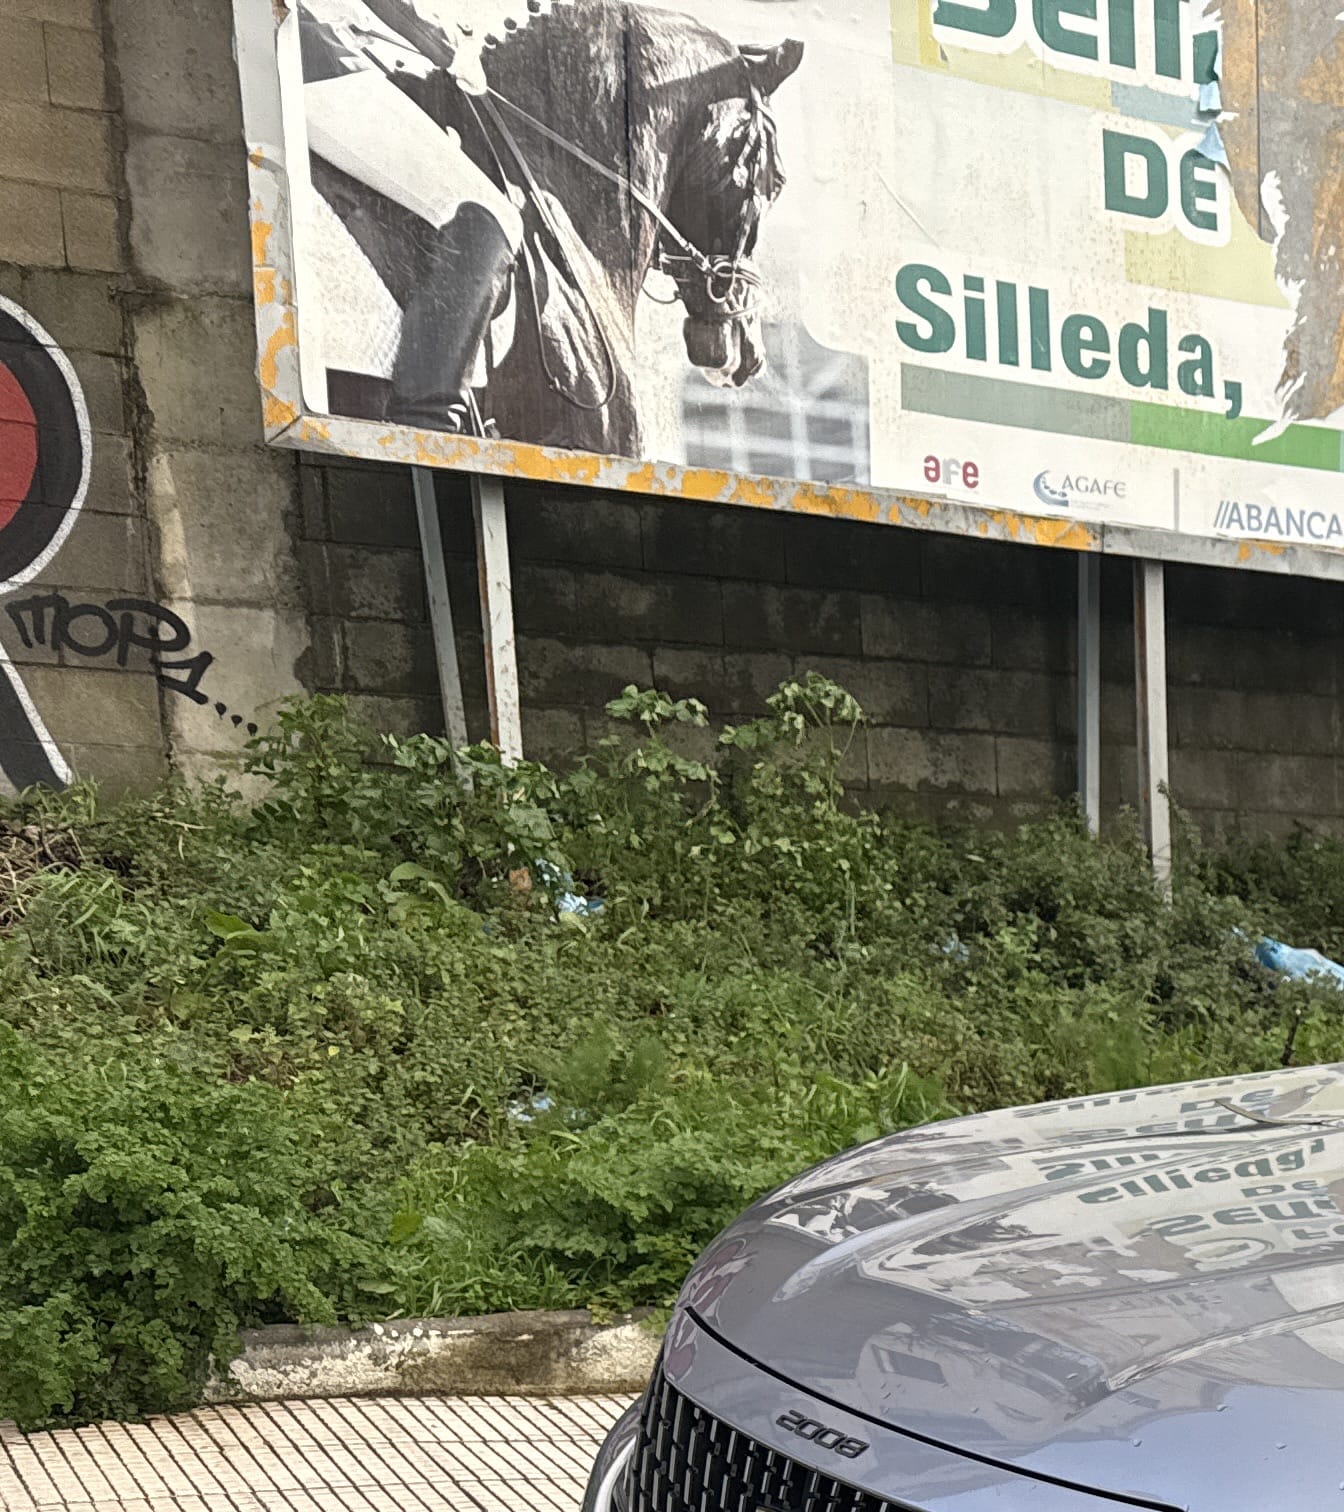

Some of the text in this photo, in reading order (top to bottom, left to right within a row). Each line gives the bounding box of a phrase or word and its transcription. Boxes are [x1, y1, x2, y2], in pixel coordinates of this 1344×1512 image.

[1103, 128, 1218, 231] DE
[896, 263, 1242, 420] Silleda,
[776, 1409, 870, 1459] 2008
